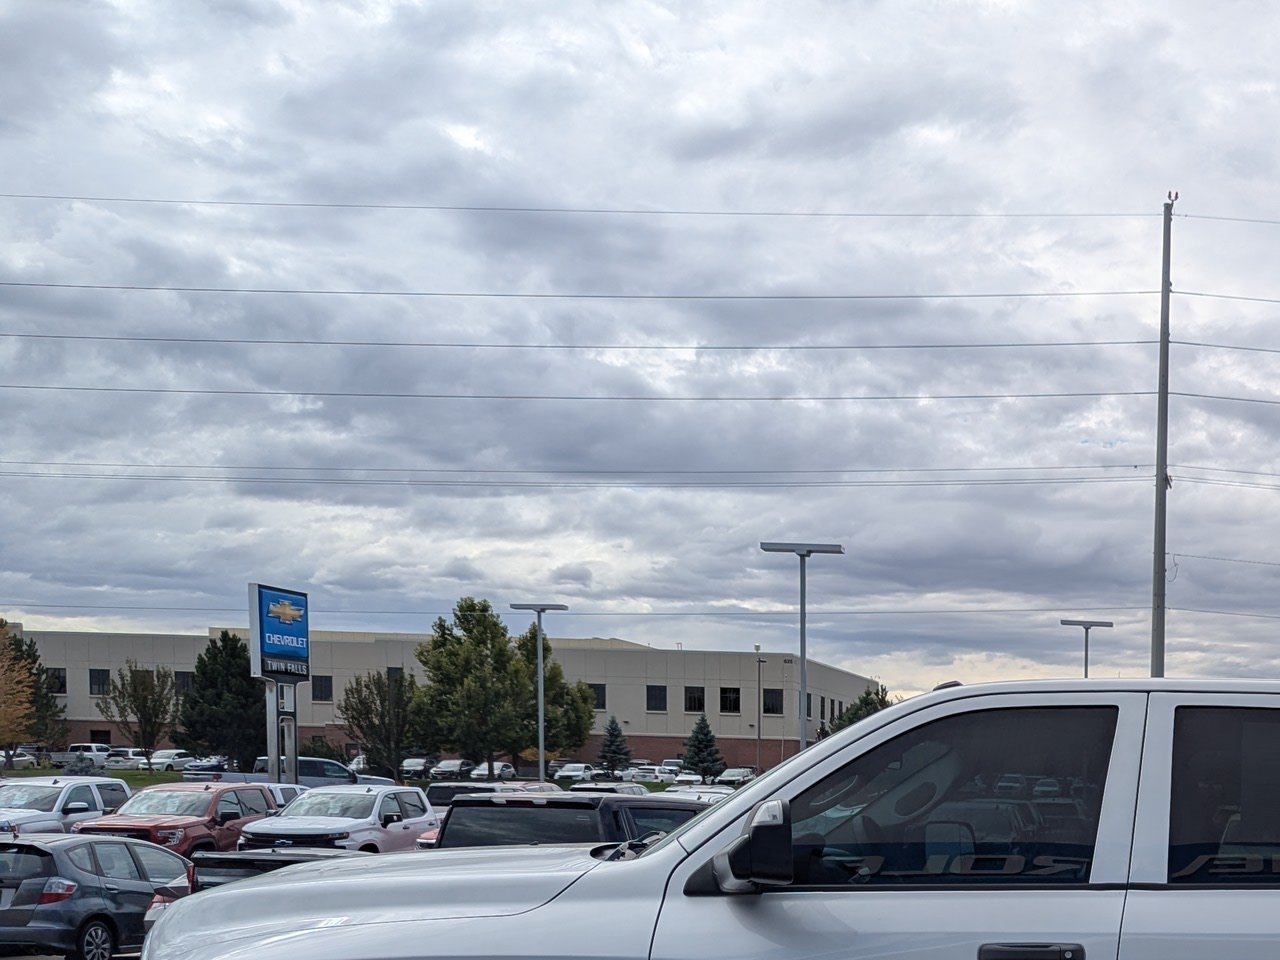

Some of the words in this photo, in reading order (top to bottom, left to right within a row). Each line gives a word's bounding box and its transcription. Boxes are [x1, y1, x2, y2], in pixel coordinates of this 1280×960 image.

[266, 633, 307, 648] CHEVROLET
[267, 660, 286, 672] TWIN
[287, 663, 307, 675] FALLS
